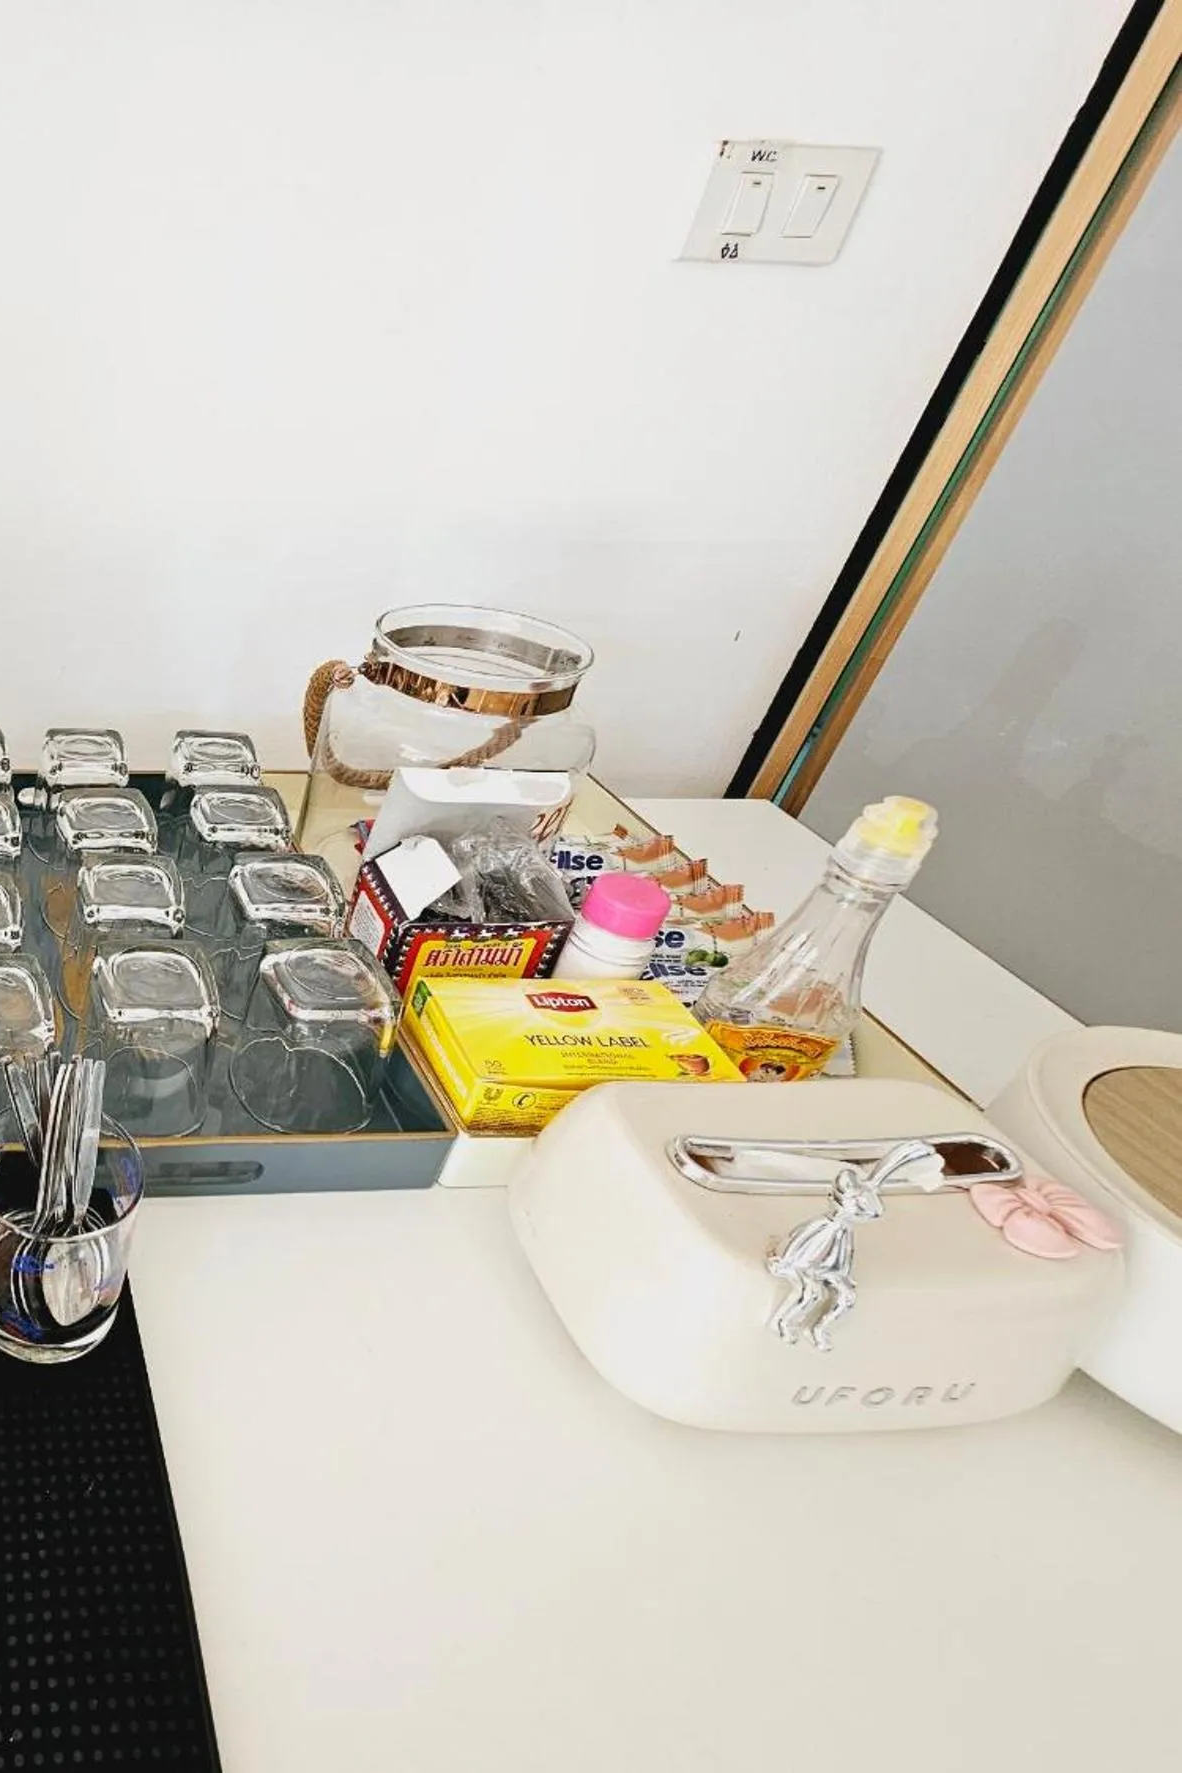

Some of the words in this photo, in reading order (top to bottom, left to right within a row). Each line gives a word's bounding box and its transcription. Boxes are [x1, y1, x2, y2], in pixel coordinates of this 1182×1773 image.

[533, 995, 591, 1008] Lipton
[524, 1034, 594, 1047] YELLOW
[596, 1035, 652, 1048] LABEL
[791, 1382, 977, 1408] UFORU
